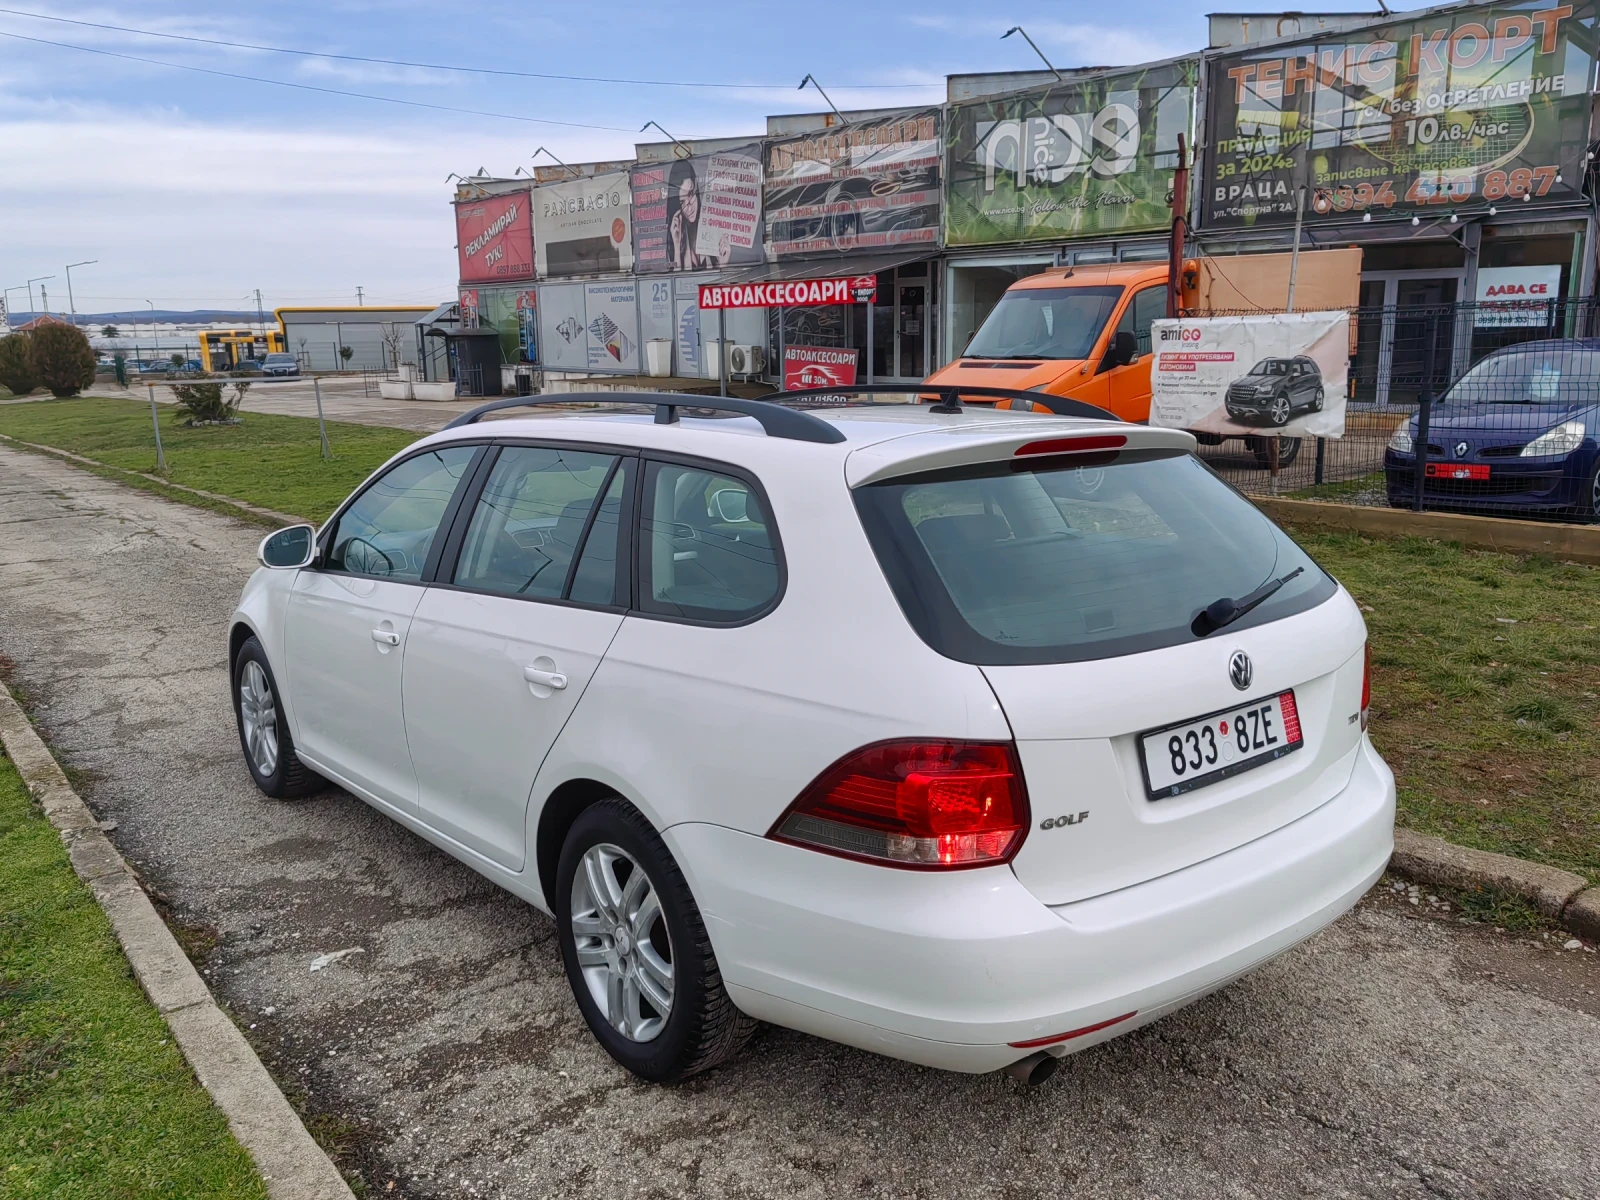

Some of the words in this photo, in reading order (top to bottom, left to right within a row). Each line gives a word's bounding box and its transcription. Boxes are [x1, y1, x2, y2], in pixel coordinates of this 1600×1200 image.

[1228, 40, 1394, 105] ТЕНИС
[1407, 5, 1573, 77] КОРТ
[1426, 75, 1565, 107] ОСВЕТЛЕНИЕ
[768, 116, 935, 172] АВТОАКСЕСОАРИ
[1217, 128, 1312, 154] ПРОМОЦИЯ
[1316, 165, 1389, 185] записване
[1414, 157, 1473, 173] часове:
[1215, 180, 1295, 202] ВРАЦА,
[1313, 180, 1397, 214] 0894
[1405, 174, 1473, 206] 420
[1481, 165, 1560, 201] 887
[543, 191, 621, 218] PANCRACIO
[983, 206, 1026, 216] www.nice.bg
[1029, 198, 1066, 216] Follow
[1068, 194, 1091, 209] the
[1093, 190, 1138, 209] Flavor
[465, 203, 518, 259] РЕКЛАМИРАЙ
[577, 217, 603, 226] CHOCOLATE
[485, 244, 504, 267] ТУК!
[610, 295, 634, 303] МАТЕРИАЛИ
[652, 282, 669, 302] 25
[702, 280, 848, 307] АВТОАКСЕСОАРИ
[1485, 284, 1526, 297] ДАВА
[1529, 283, 1548, 294] СЕ
[785, 349, 856, 365] АВТОАКСЕСОАРИ
[1168, 725, 1218, 776] 833
[1234, 704, 1278, 754] 8ZE
[1040, 810, 1090, 830] GOLF
